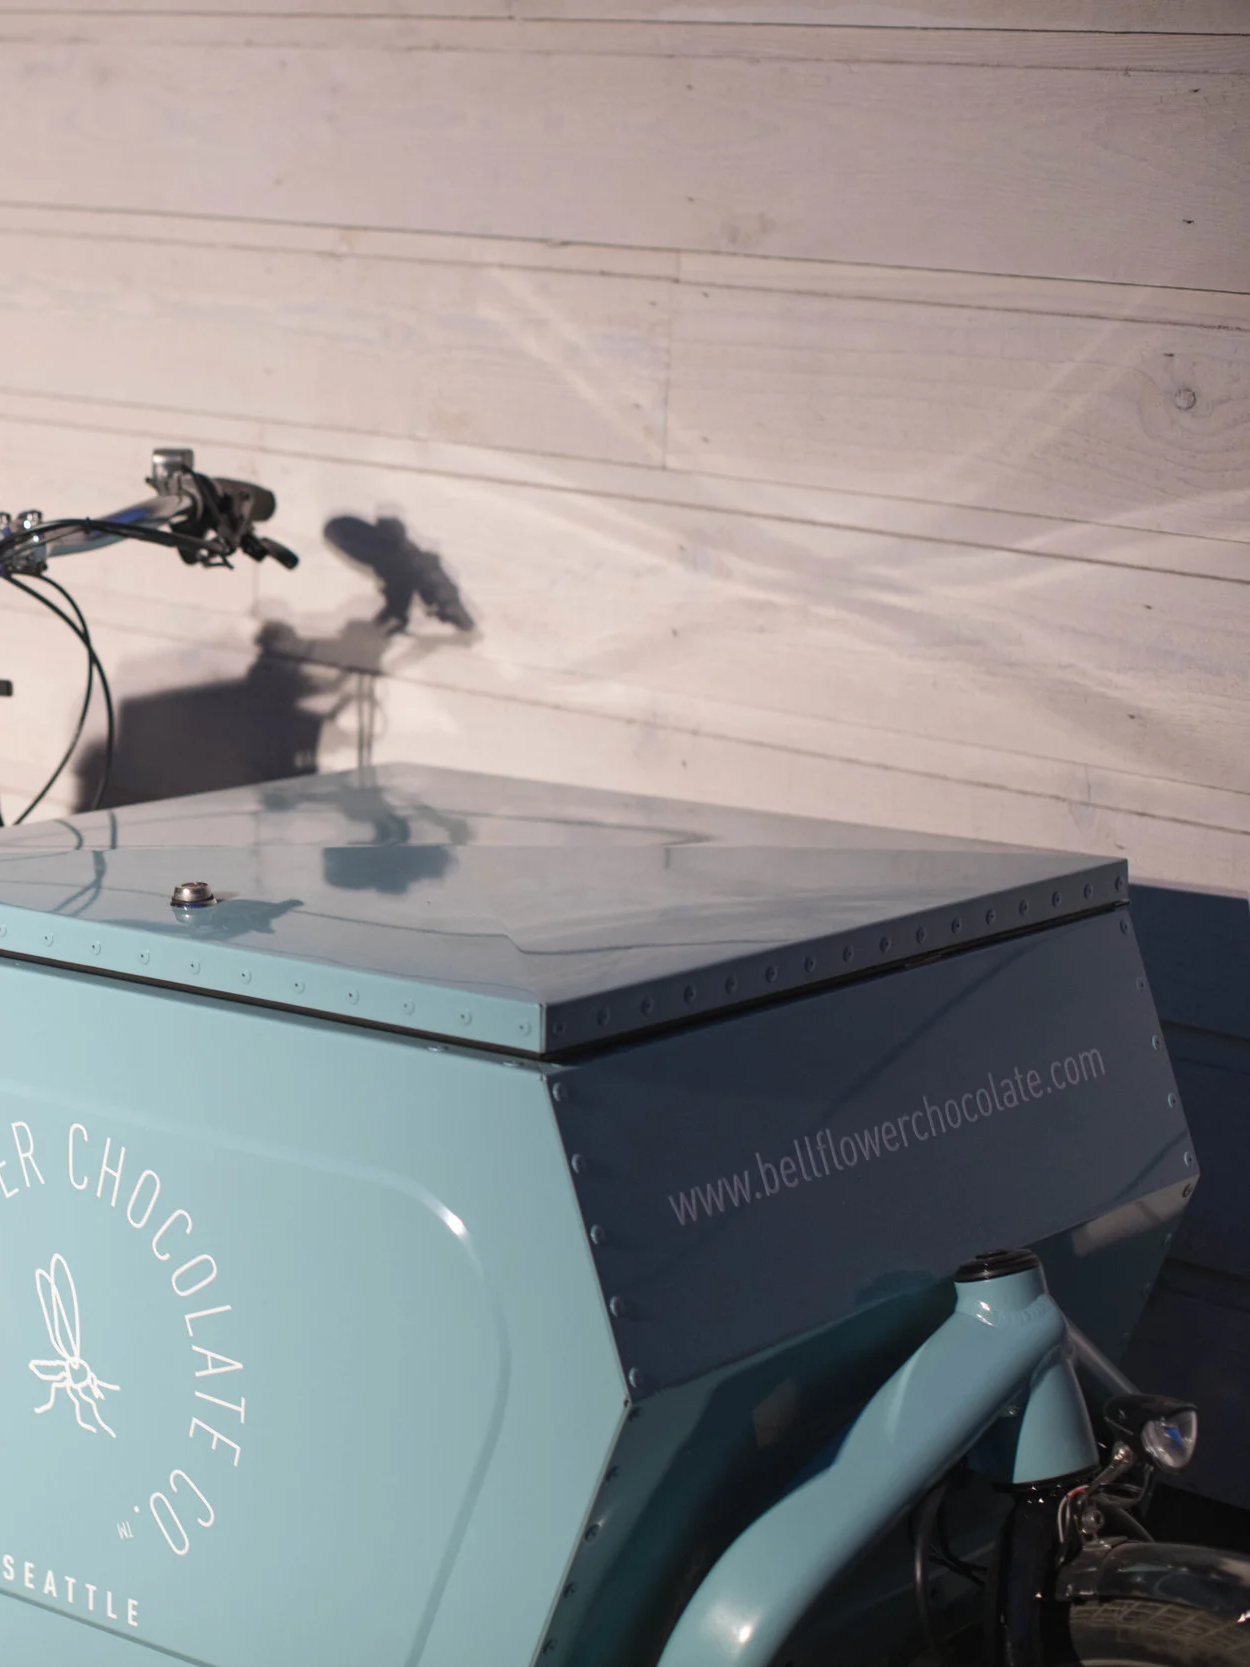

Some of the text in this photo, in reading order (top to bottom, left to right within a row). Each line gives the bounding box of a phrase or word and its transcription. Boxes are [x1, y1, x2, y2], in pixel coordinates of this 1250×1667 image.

[668, 1047, 1106, 1226] www.bellflowerchocolate.com
[68, 1123, 246, 1468] CHOCOLATE
[133, 1468, 215, 1556] CO.
[2, 1554, 139, 1628] SEATTLE
